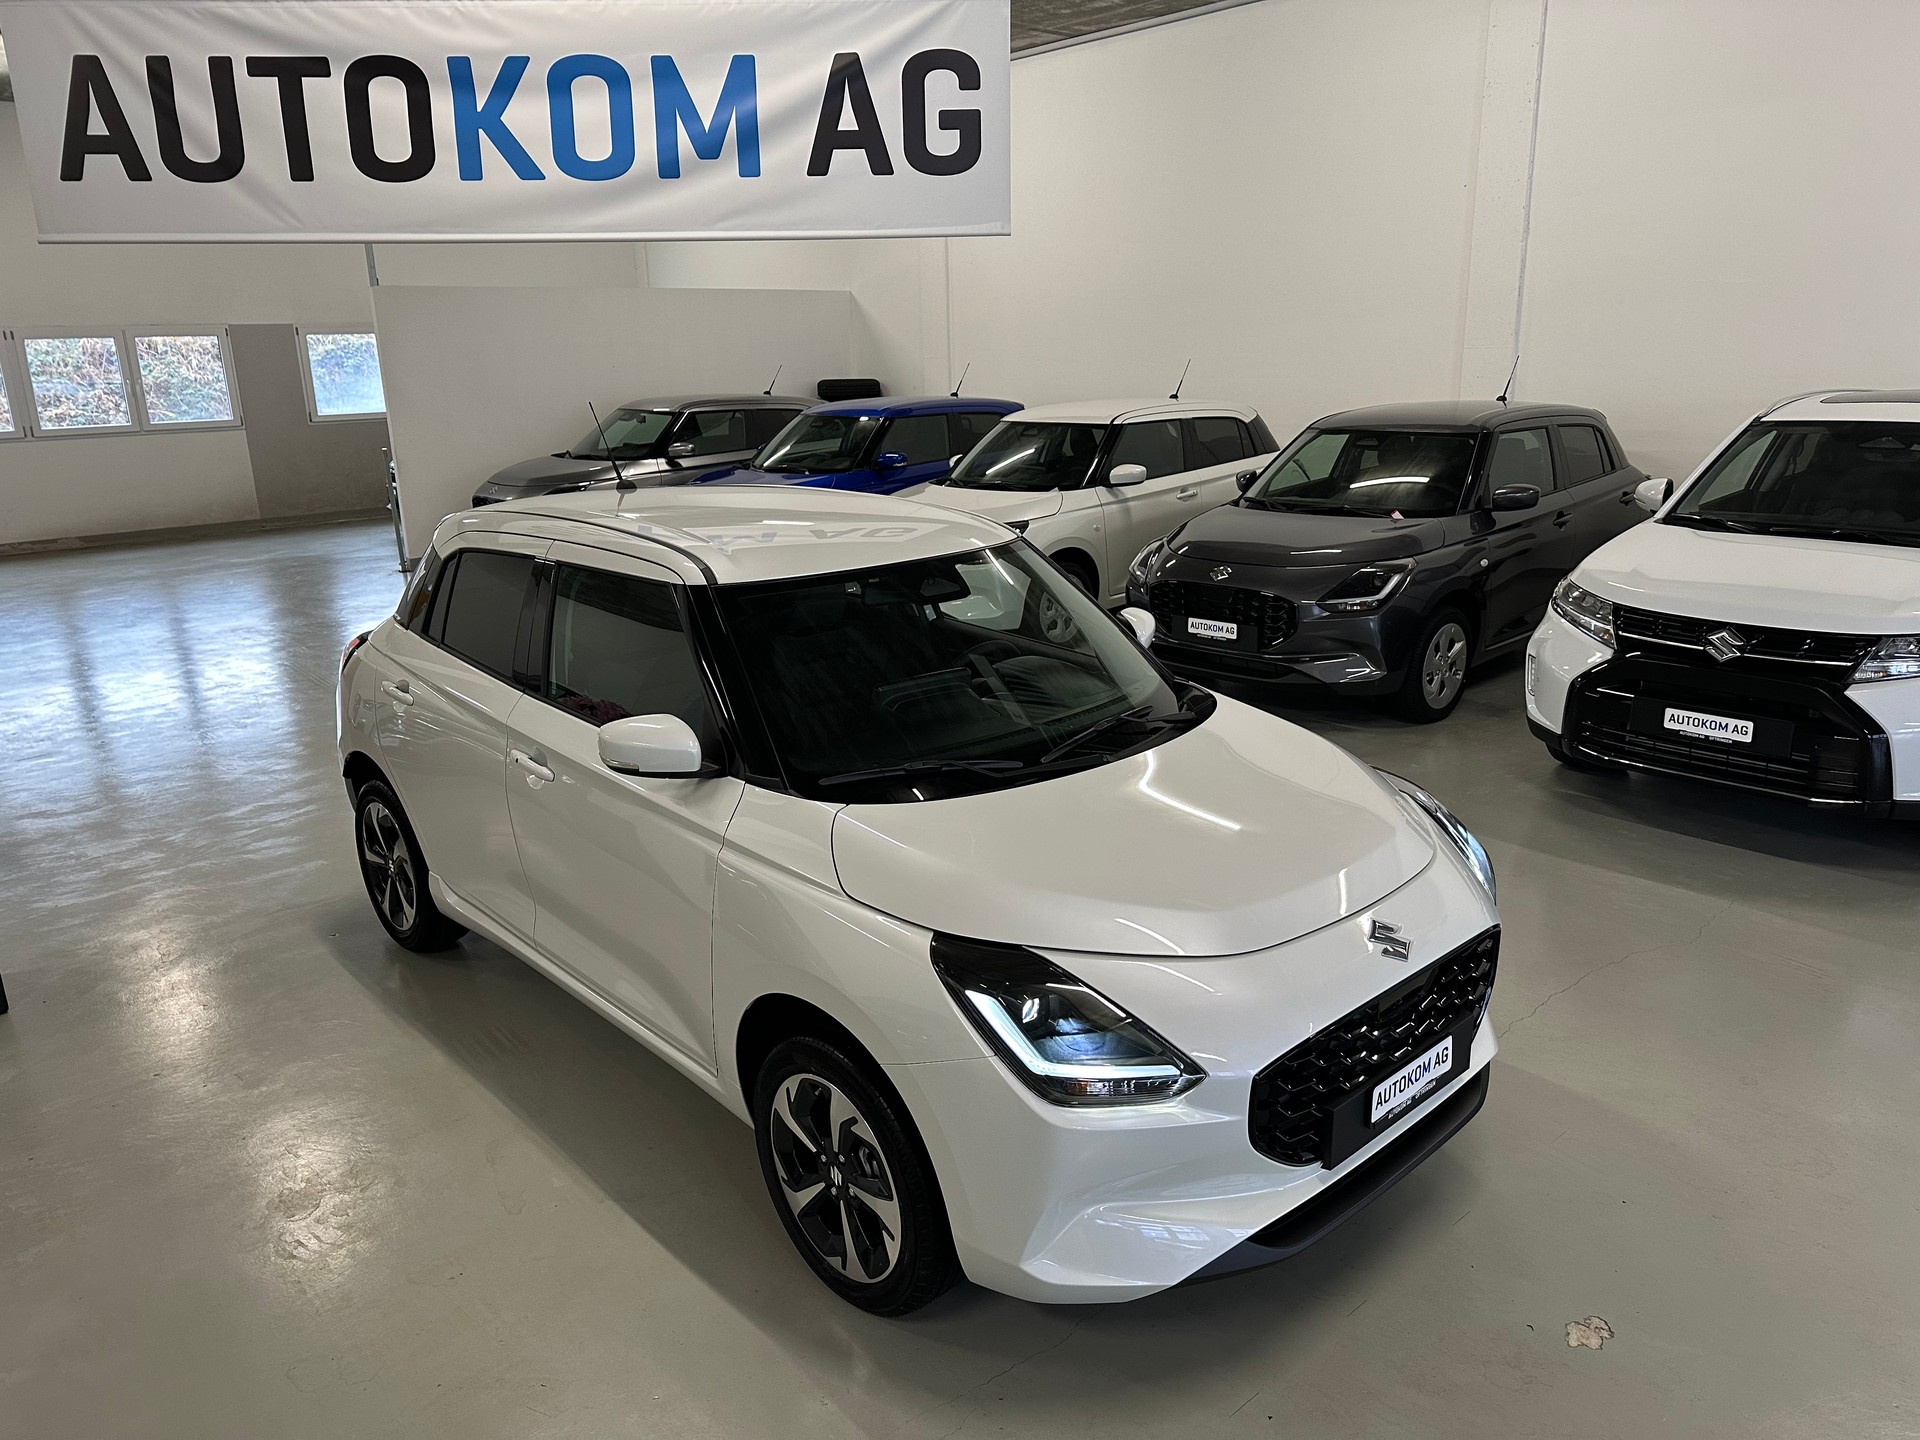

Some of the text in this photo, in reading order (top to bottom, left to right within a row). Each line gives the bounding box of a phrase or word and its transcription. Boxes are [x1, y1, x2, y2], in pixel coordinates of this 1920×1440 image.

[60, 48, 983, 182] AUTOKOM AG
[1190, 621, 1235, 635] AUTOKOM AG
[1668, 713, 1749, 736] AUTOKOM AG
[1375, 1046, 1449, 1111] AUTOKOM AG
